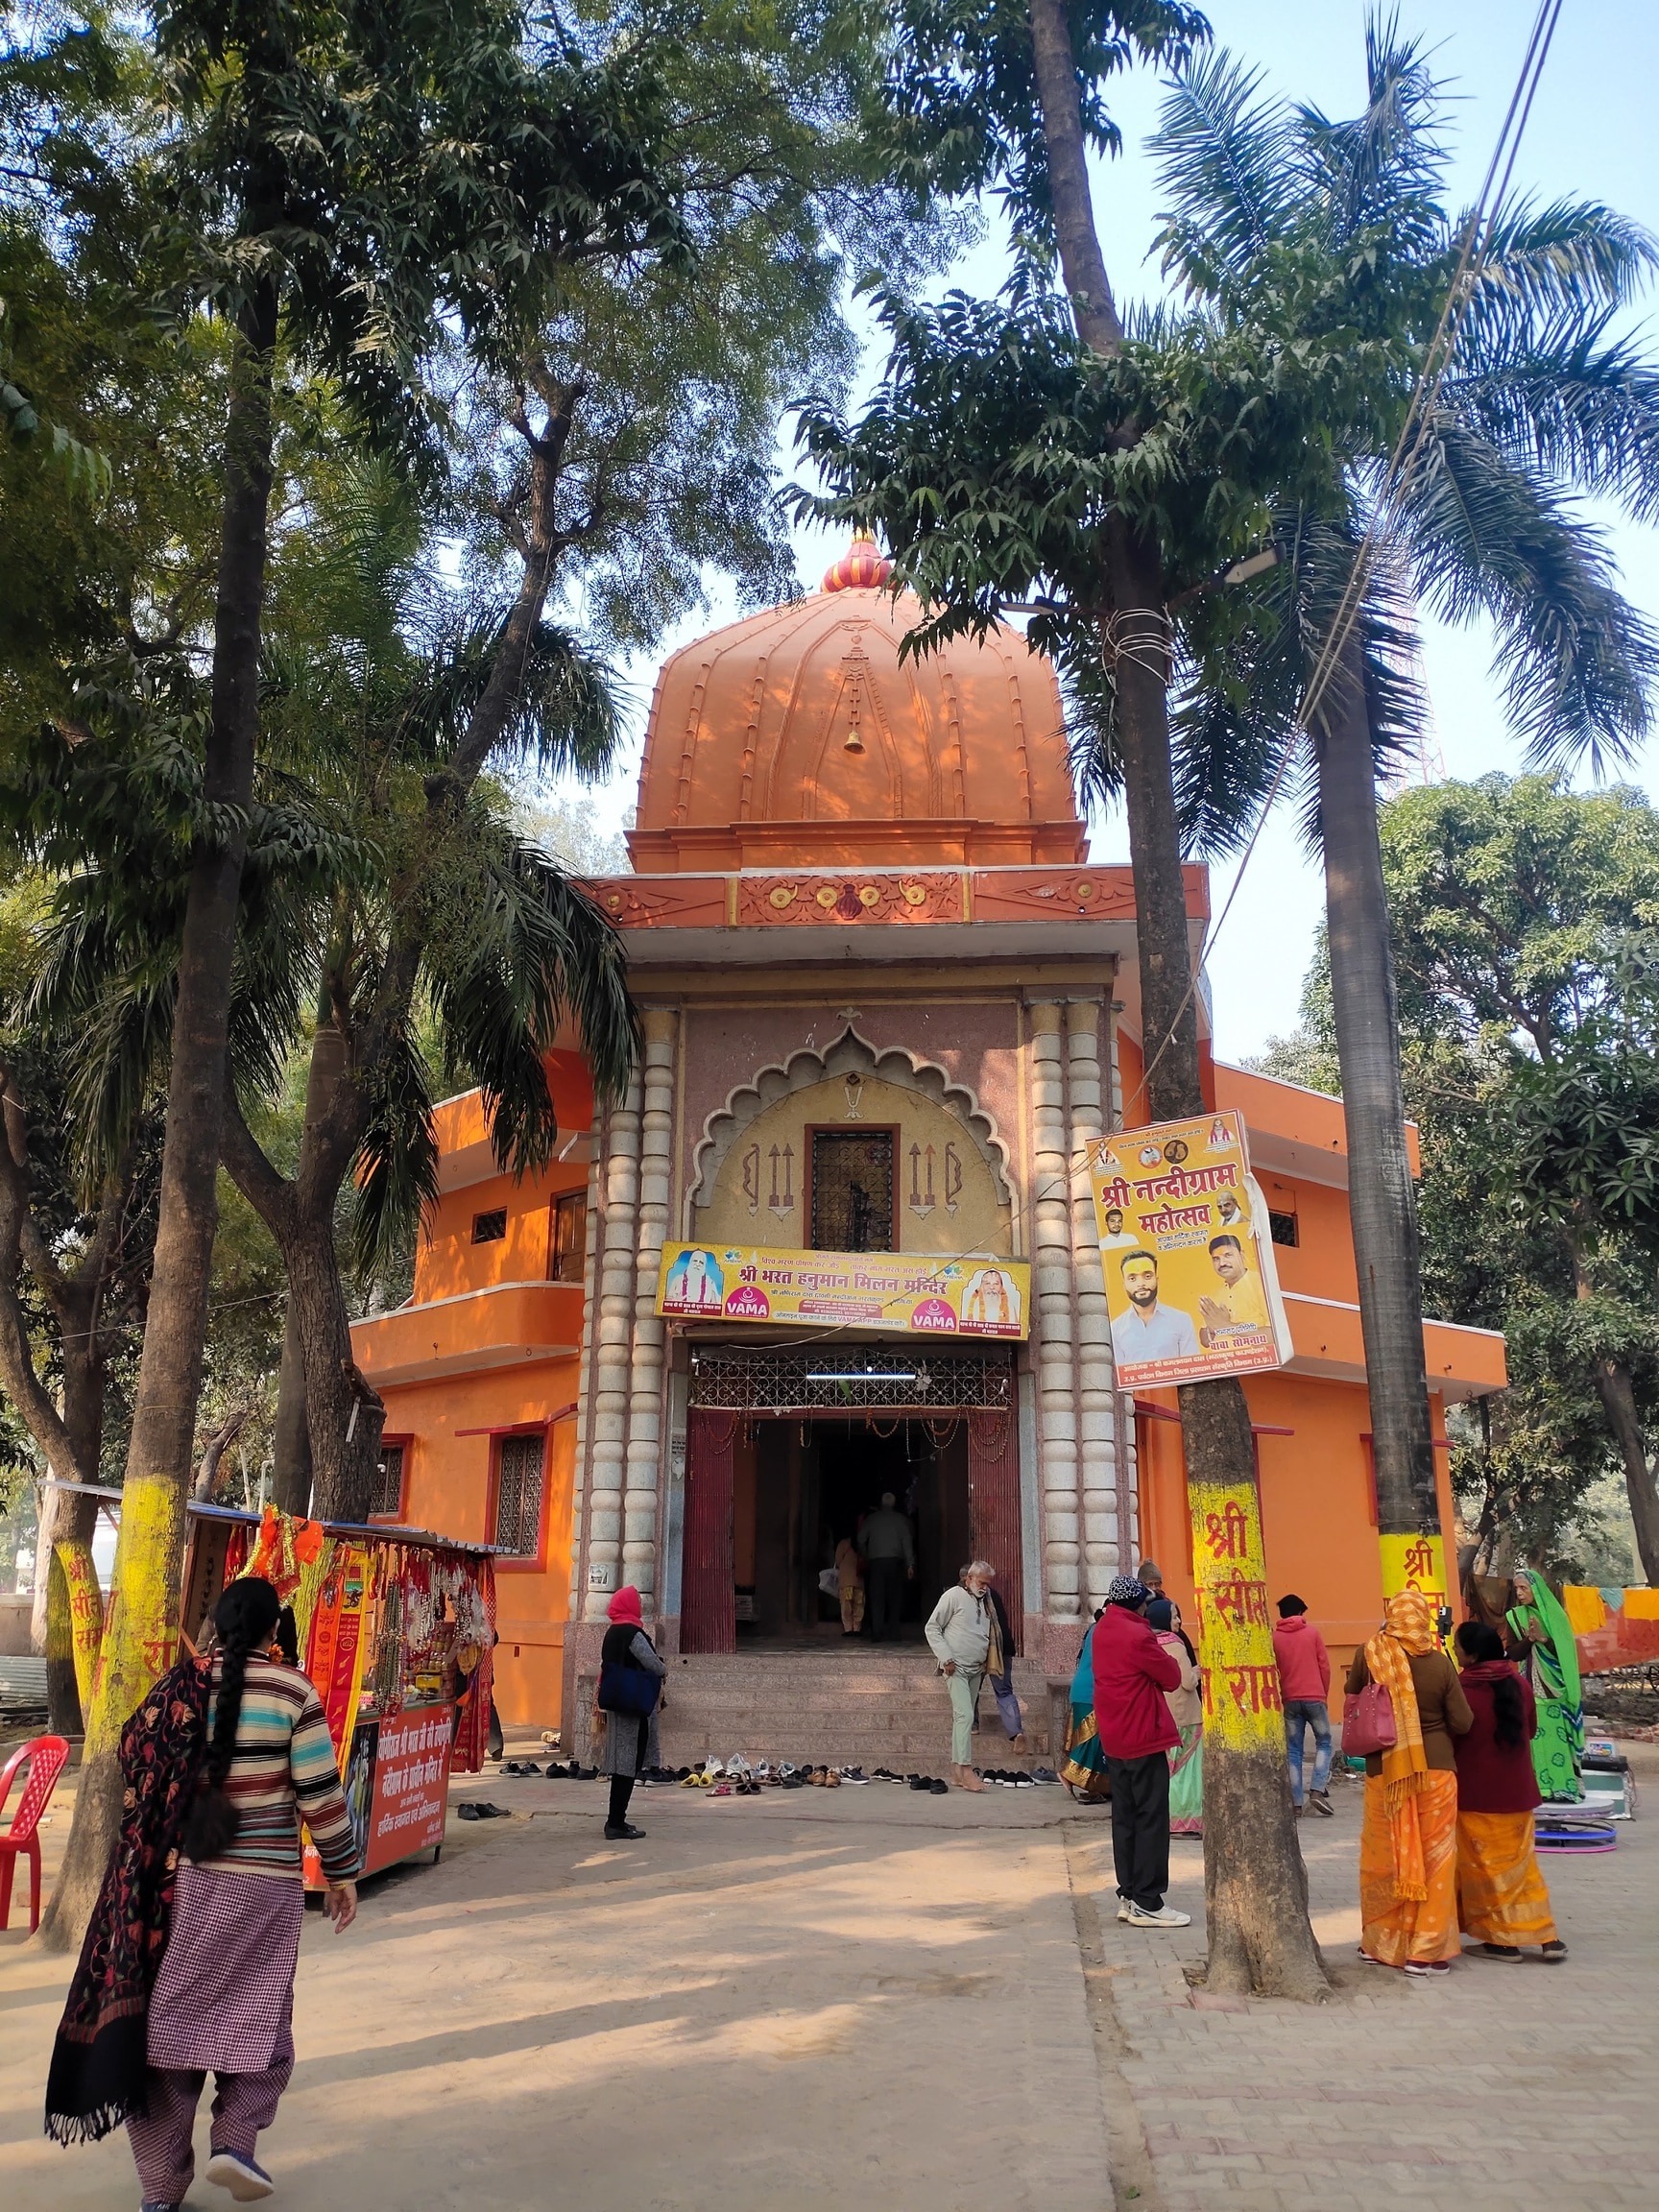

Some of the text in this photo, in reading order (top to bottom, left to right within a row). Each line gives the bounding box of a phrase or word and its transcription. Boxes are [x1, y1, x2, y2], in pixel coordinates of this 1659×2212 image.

[1101, 1164, 1237, 1209] श्री नन्दीग्राम
[1139, 1203, 1211, 1234] महोत्सव
[739, 1265, 949, 1294] श्री भरत हनुमान मिलन मन्दिर
[727, 1302, 767, 1315] VAMA
[913, 1315, 955, 1329] VAMA
[1232, 1334, 1267, 1347] सोमनाथ
[1206, 1501, 1248, 1559] श्री
[1404, 1539, 1433, 1577] श्री
[1221, 1664, 1282, 1718] राम
[419, 1721, 426, 1750] जी
